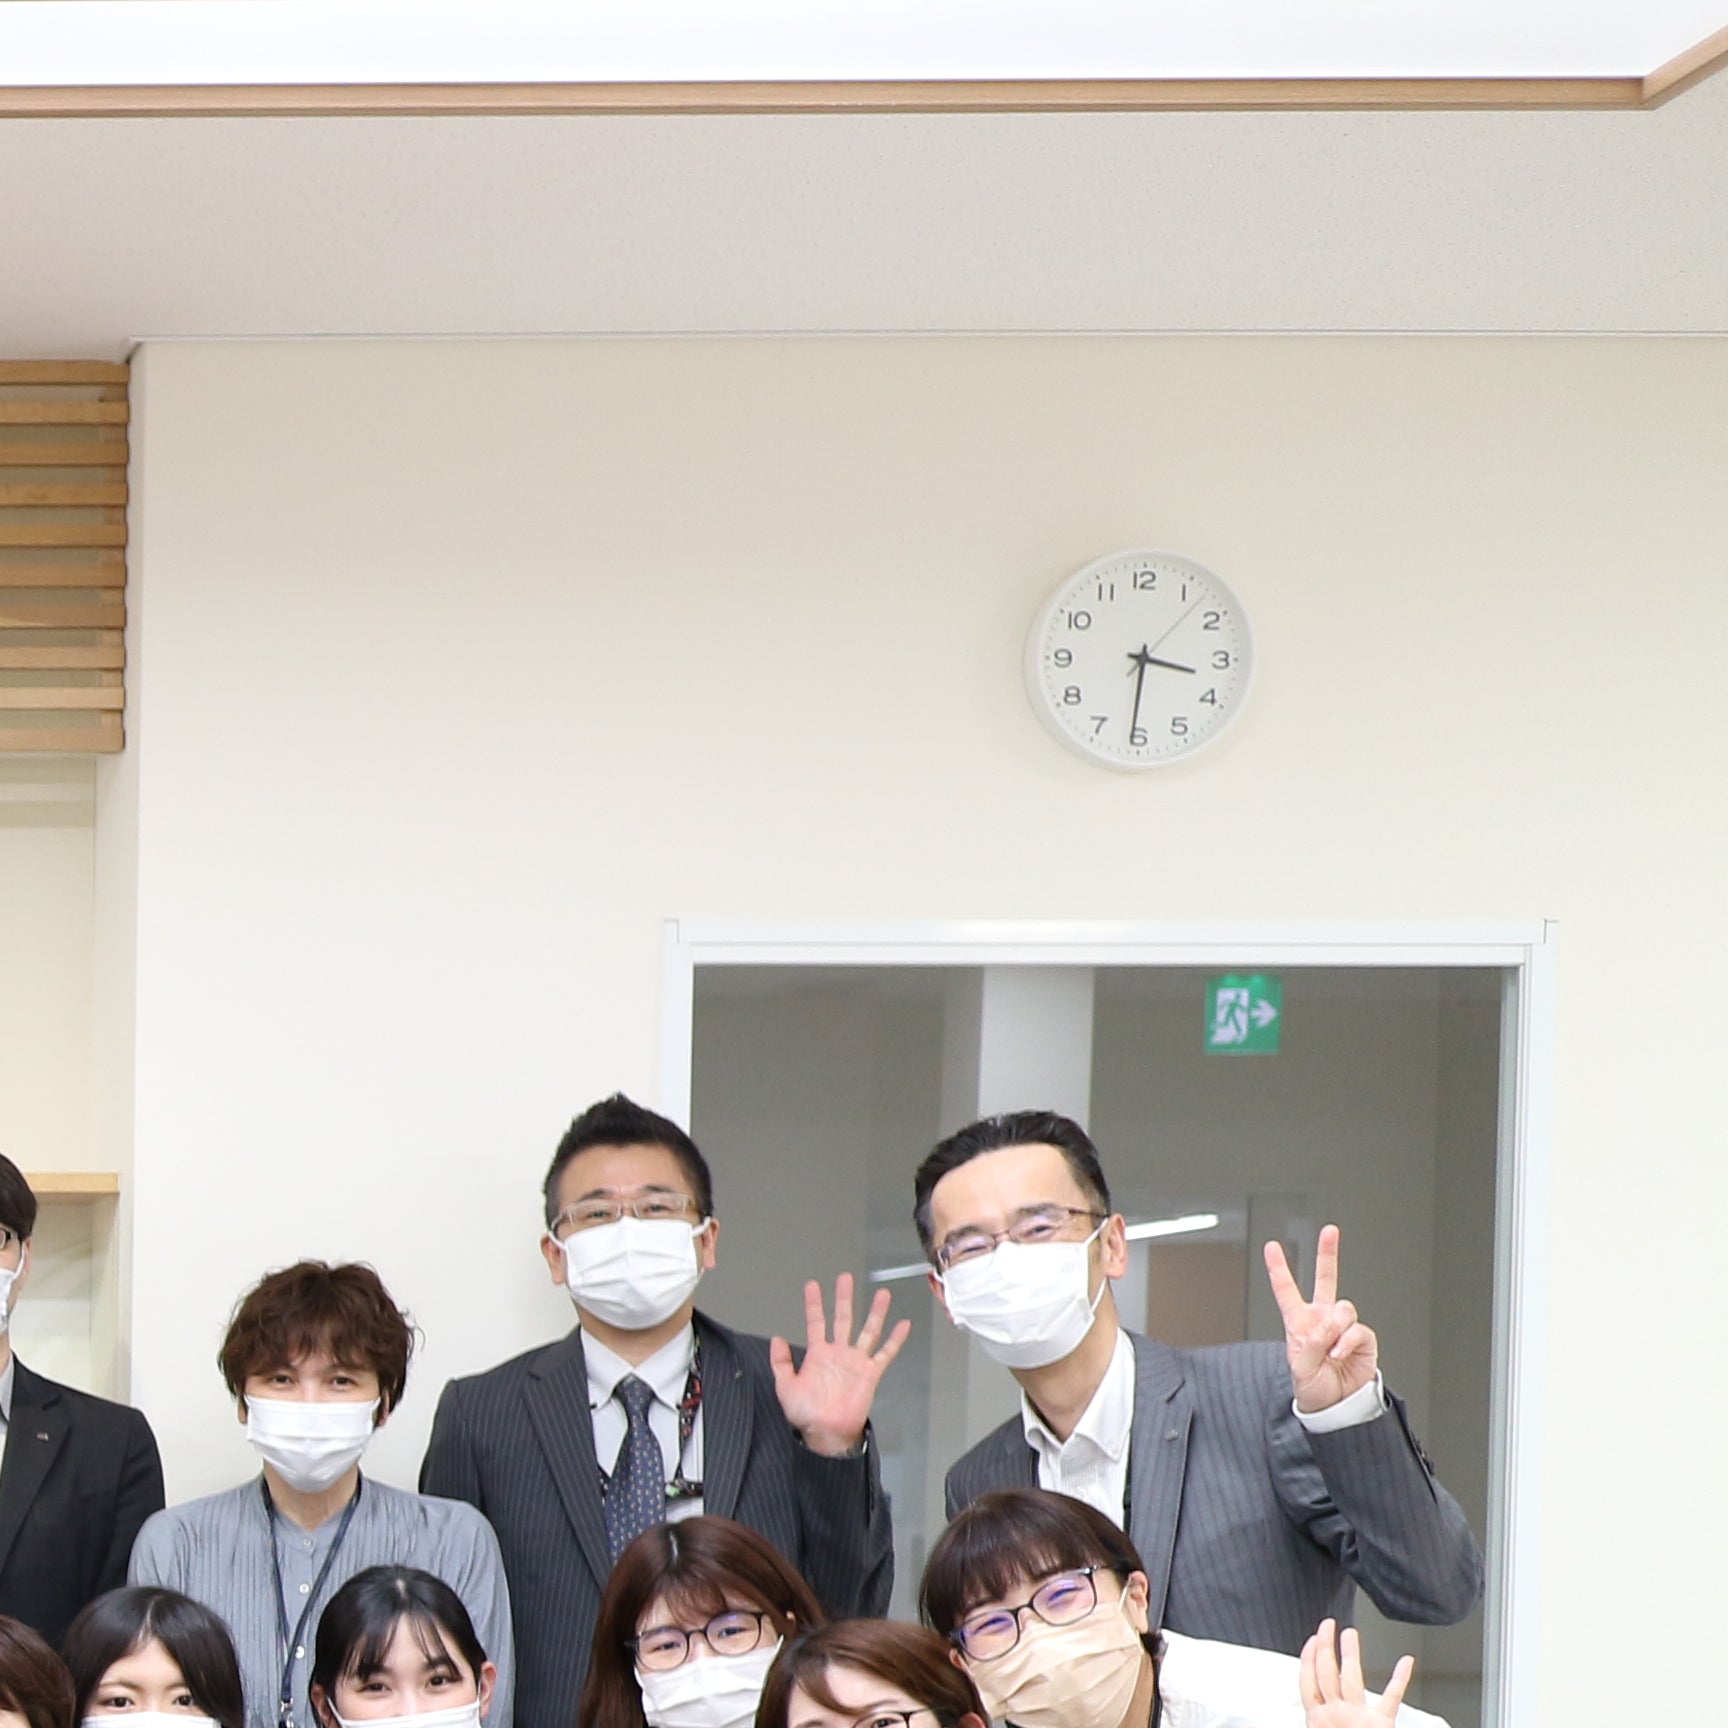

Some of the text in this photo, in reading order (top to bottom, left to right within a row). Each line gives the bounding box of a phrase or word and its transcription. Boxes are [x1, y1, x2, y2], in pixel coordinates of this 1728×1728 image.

[1133, 570, 1157, 590] 12
[1098, 583, 1114, 601] 11
[1067, 610, 1092, 630] 10
[1202, 611, 1220, 630] 2
[1054, 648, 1073, 668] 9
[1211, 650, 1230, 670] 3
[1063, 685, 1081, 705] 8
[1199, 688, 1217, 706] 4
[1091, 716, 1108, 735] 7
[1170, 716, 1188, 736] 5
[1130, 727, 1148, 746] 6
